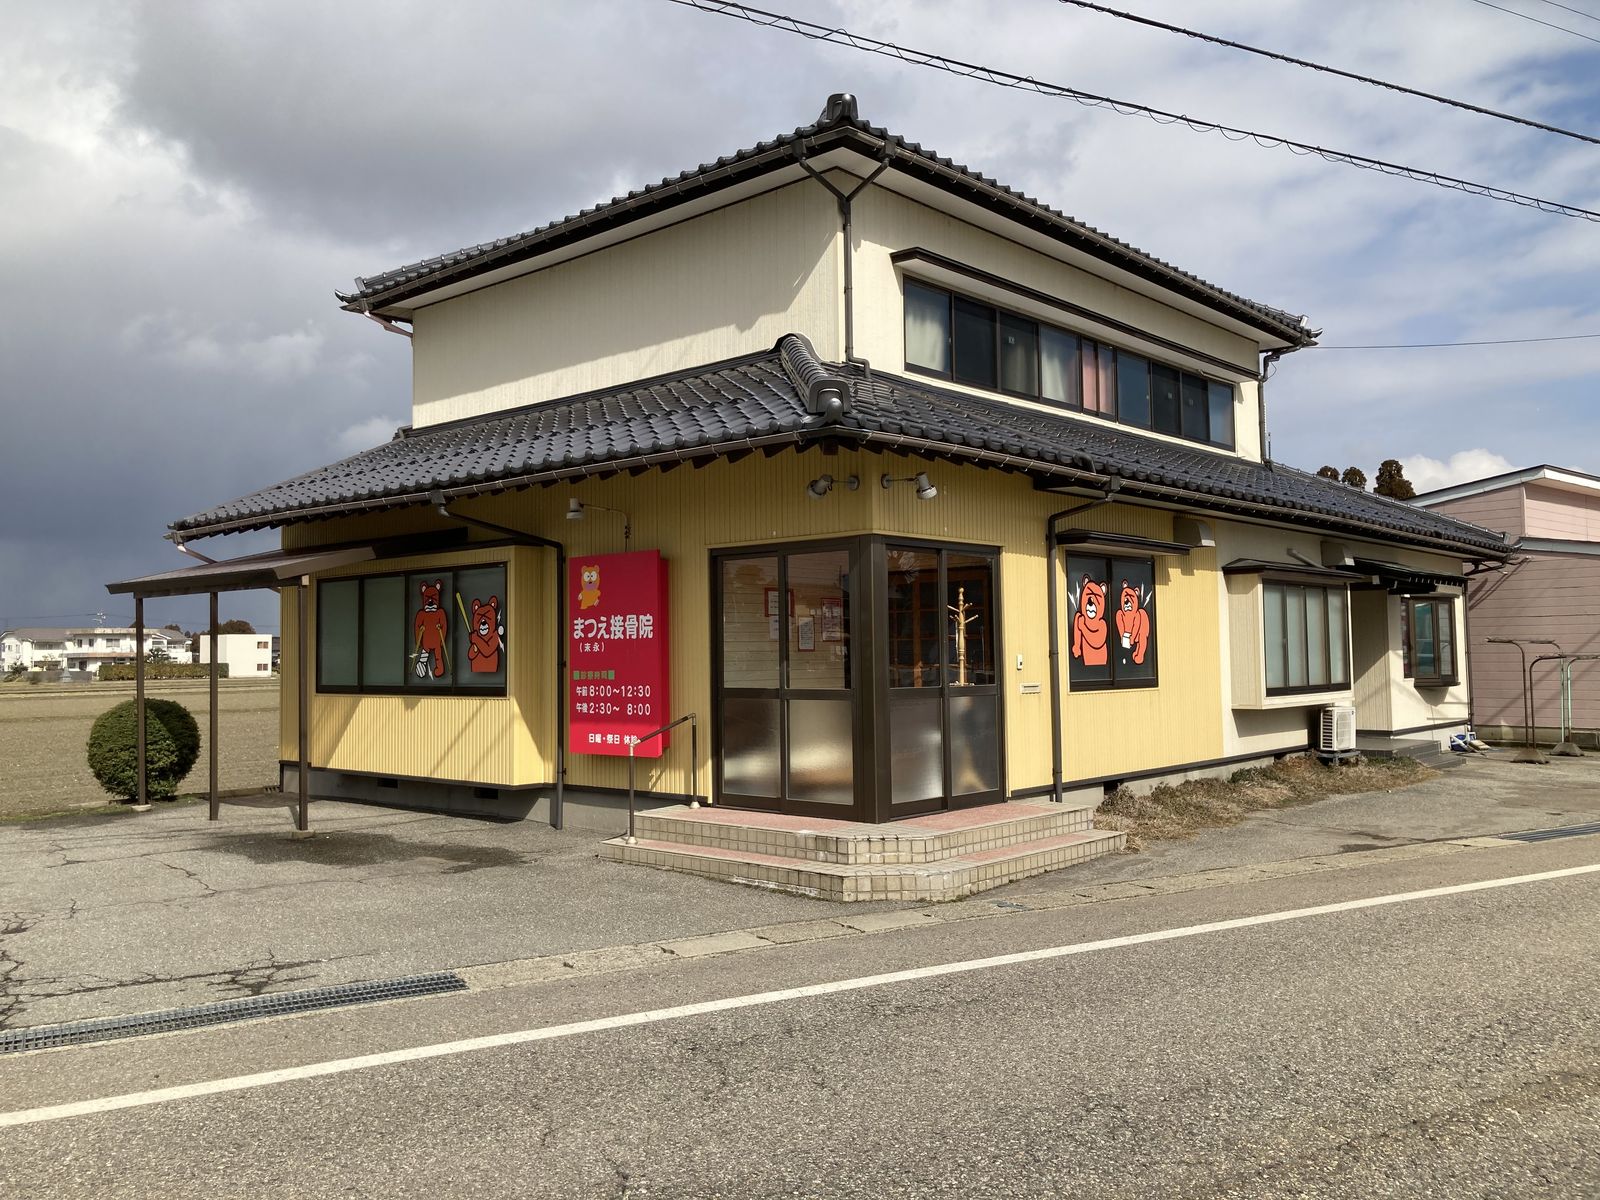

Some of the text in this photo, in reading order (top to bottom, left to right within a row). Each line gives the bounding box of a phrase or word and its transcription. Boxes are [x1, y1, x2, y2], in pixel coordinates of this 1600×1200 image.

[573, 613, 654, 640] まつえ接骨院
